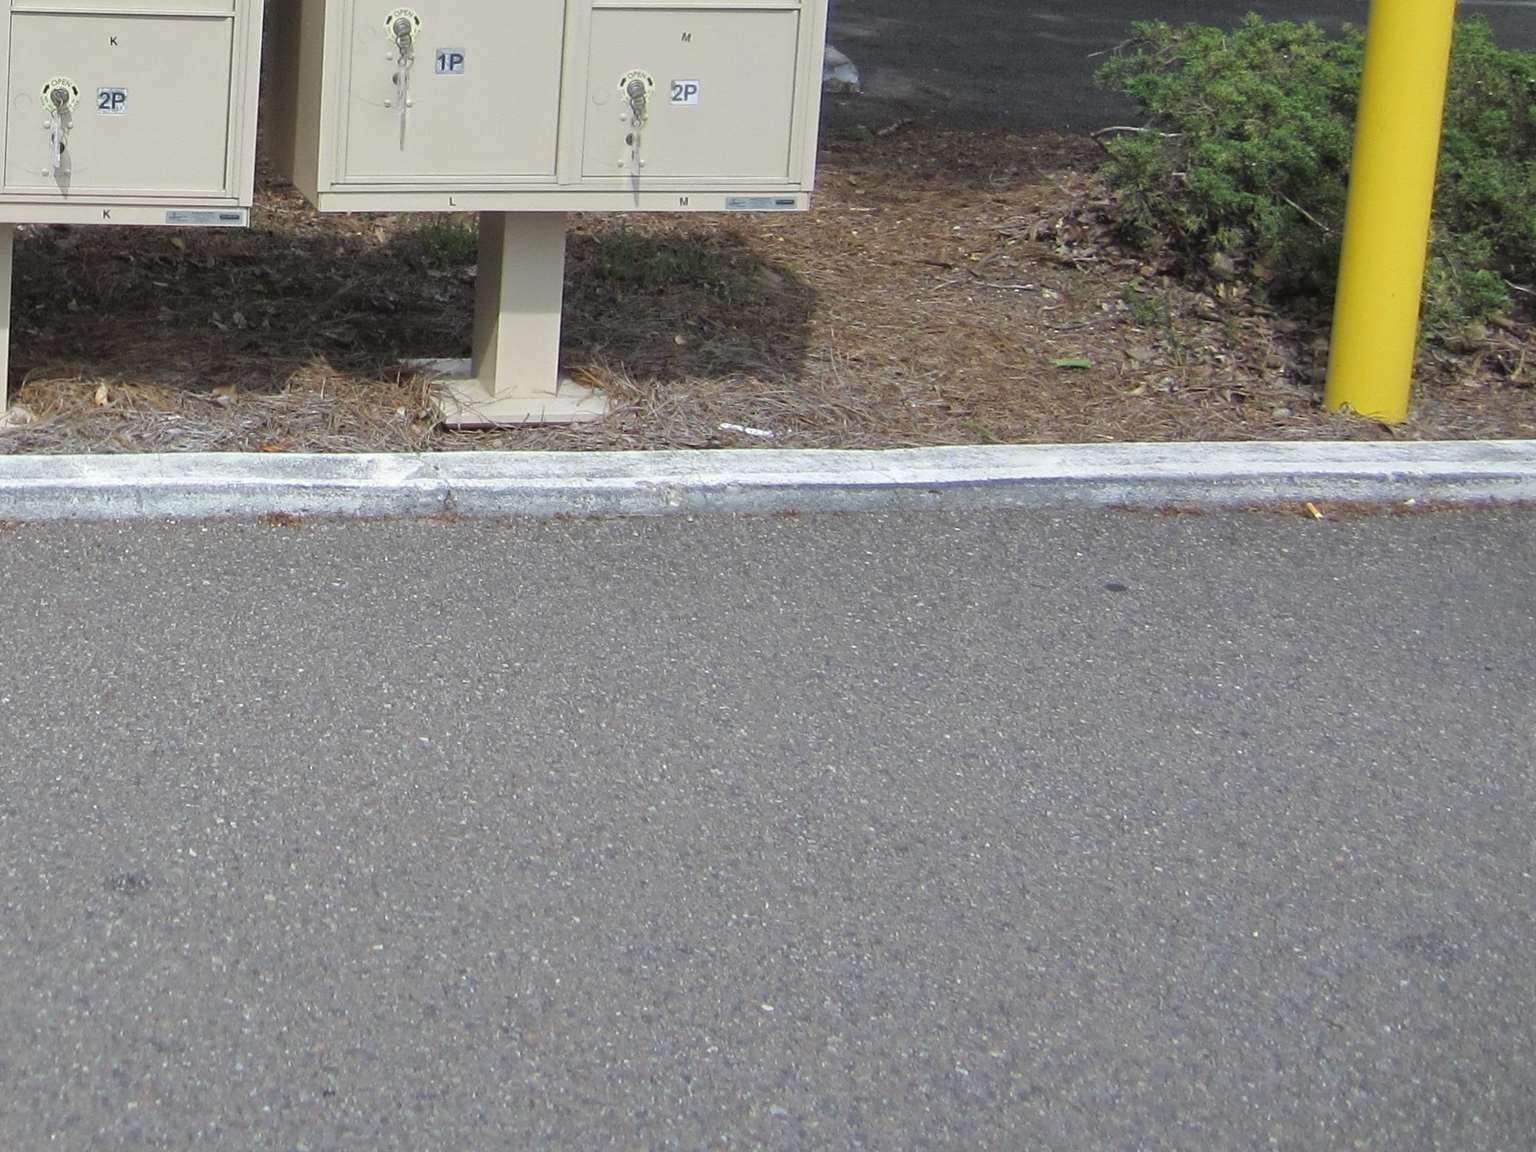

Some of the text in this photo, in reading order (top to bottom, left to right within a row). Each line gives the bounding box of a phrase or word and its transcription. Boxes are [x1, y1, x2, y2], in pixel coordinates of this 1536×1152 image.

[394, 8, 415, 18] OPEN
[110, 36, 118, 46] K
[681, 32, 692, 43] M
[437, 53, 464, 72] 1P
[50, 78, 72, 88] OPEN
[671, 83, 698, 102] 2P
[98, 91, 126, 110] 2P
[449, 196, 457, 207] L
[679, 196, 689, 206] M
[102, 208, 112, 219] K
